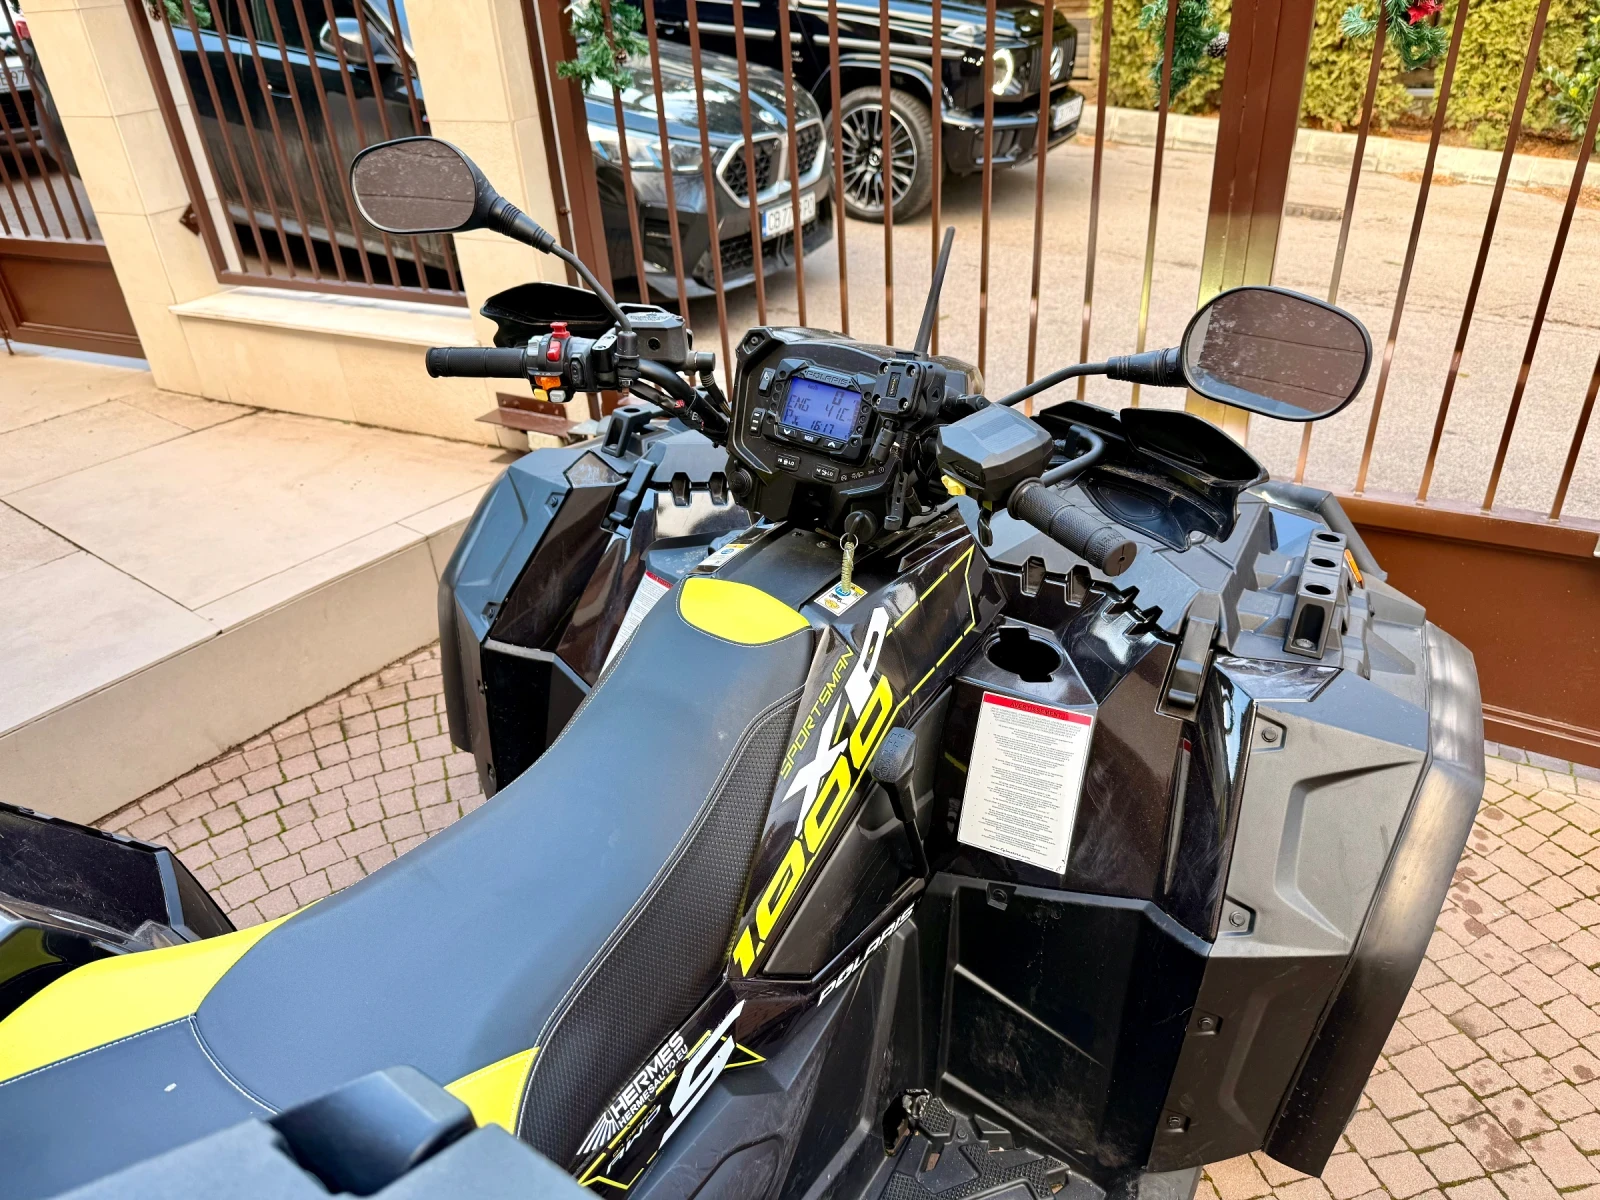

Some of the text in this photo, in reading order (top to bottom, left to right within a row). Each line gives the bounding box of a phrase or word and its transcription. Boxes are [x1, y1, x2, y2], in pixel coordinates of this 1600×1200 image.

[787, 394, 811, 412] ENG
[804, 369, 849, 386] POLARIS
[810, 420, 835, 435] 16:17
[780, 645, 854, 780] SPORTSMAN
[817, 902, 916, 1008] POLARIS
[609, 1031, 685, 1119] HERMES
[617, 1044, 689, 1129] HERMESAUTO.EU
[605, 1104, 662, 1176] AWD
